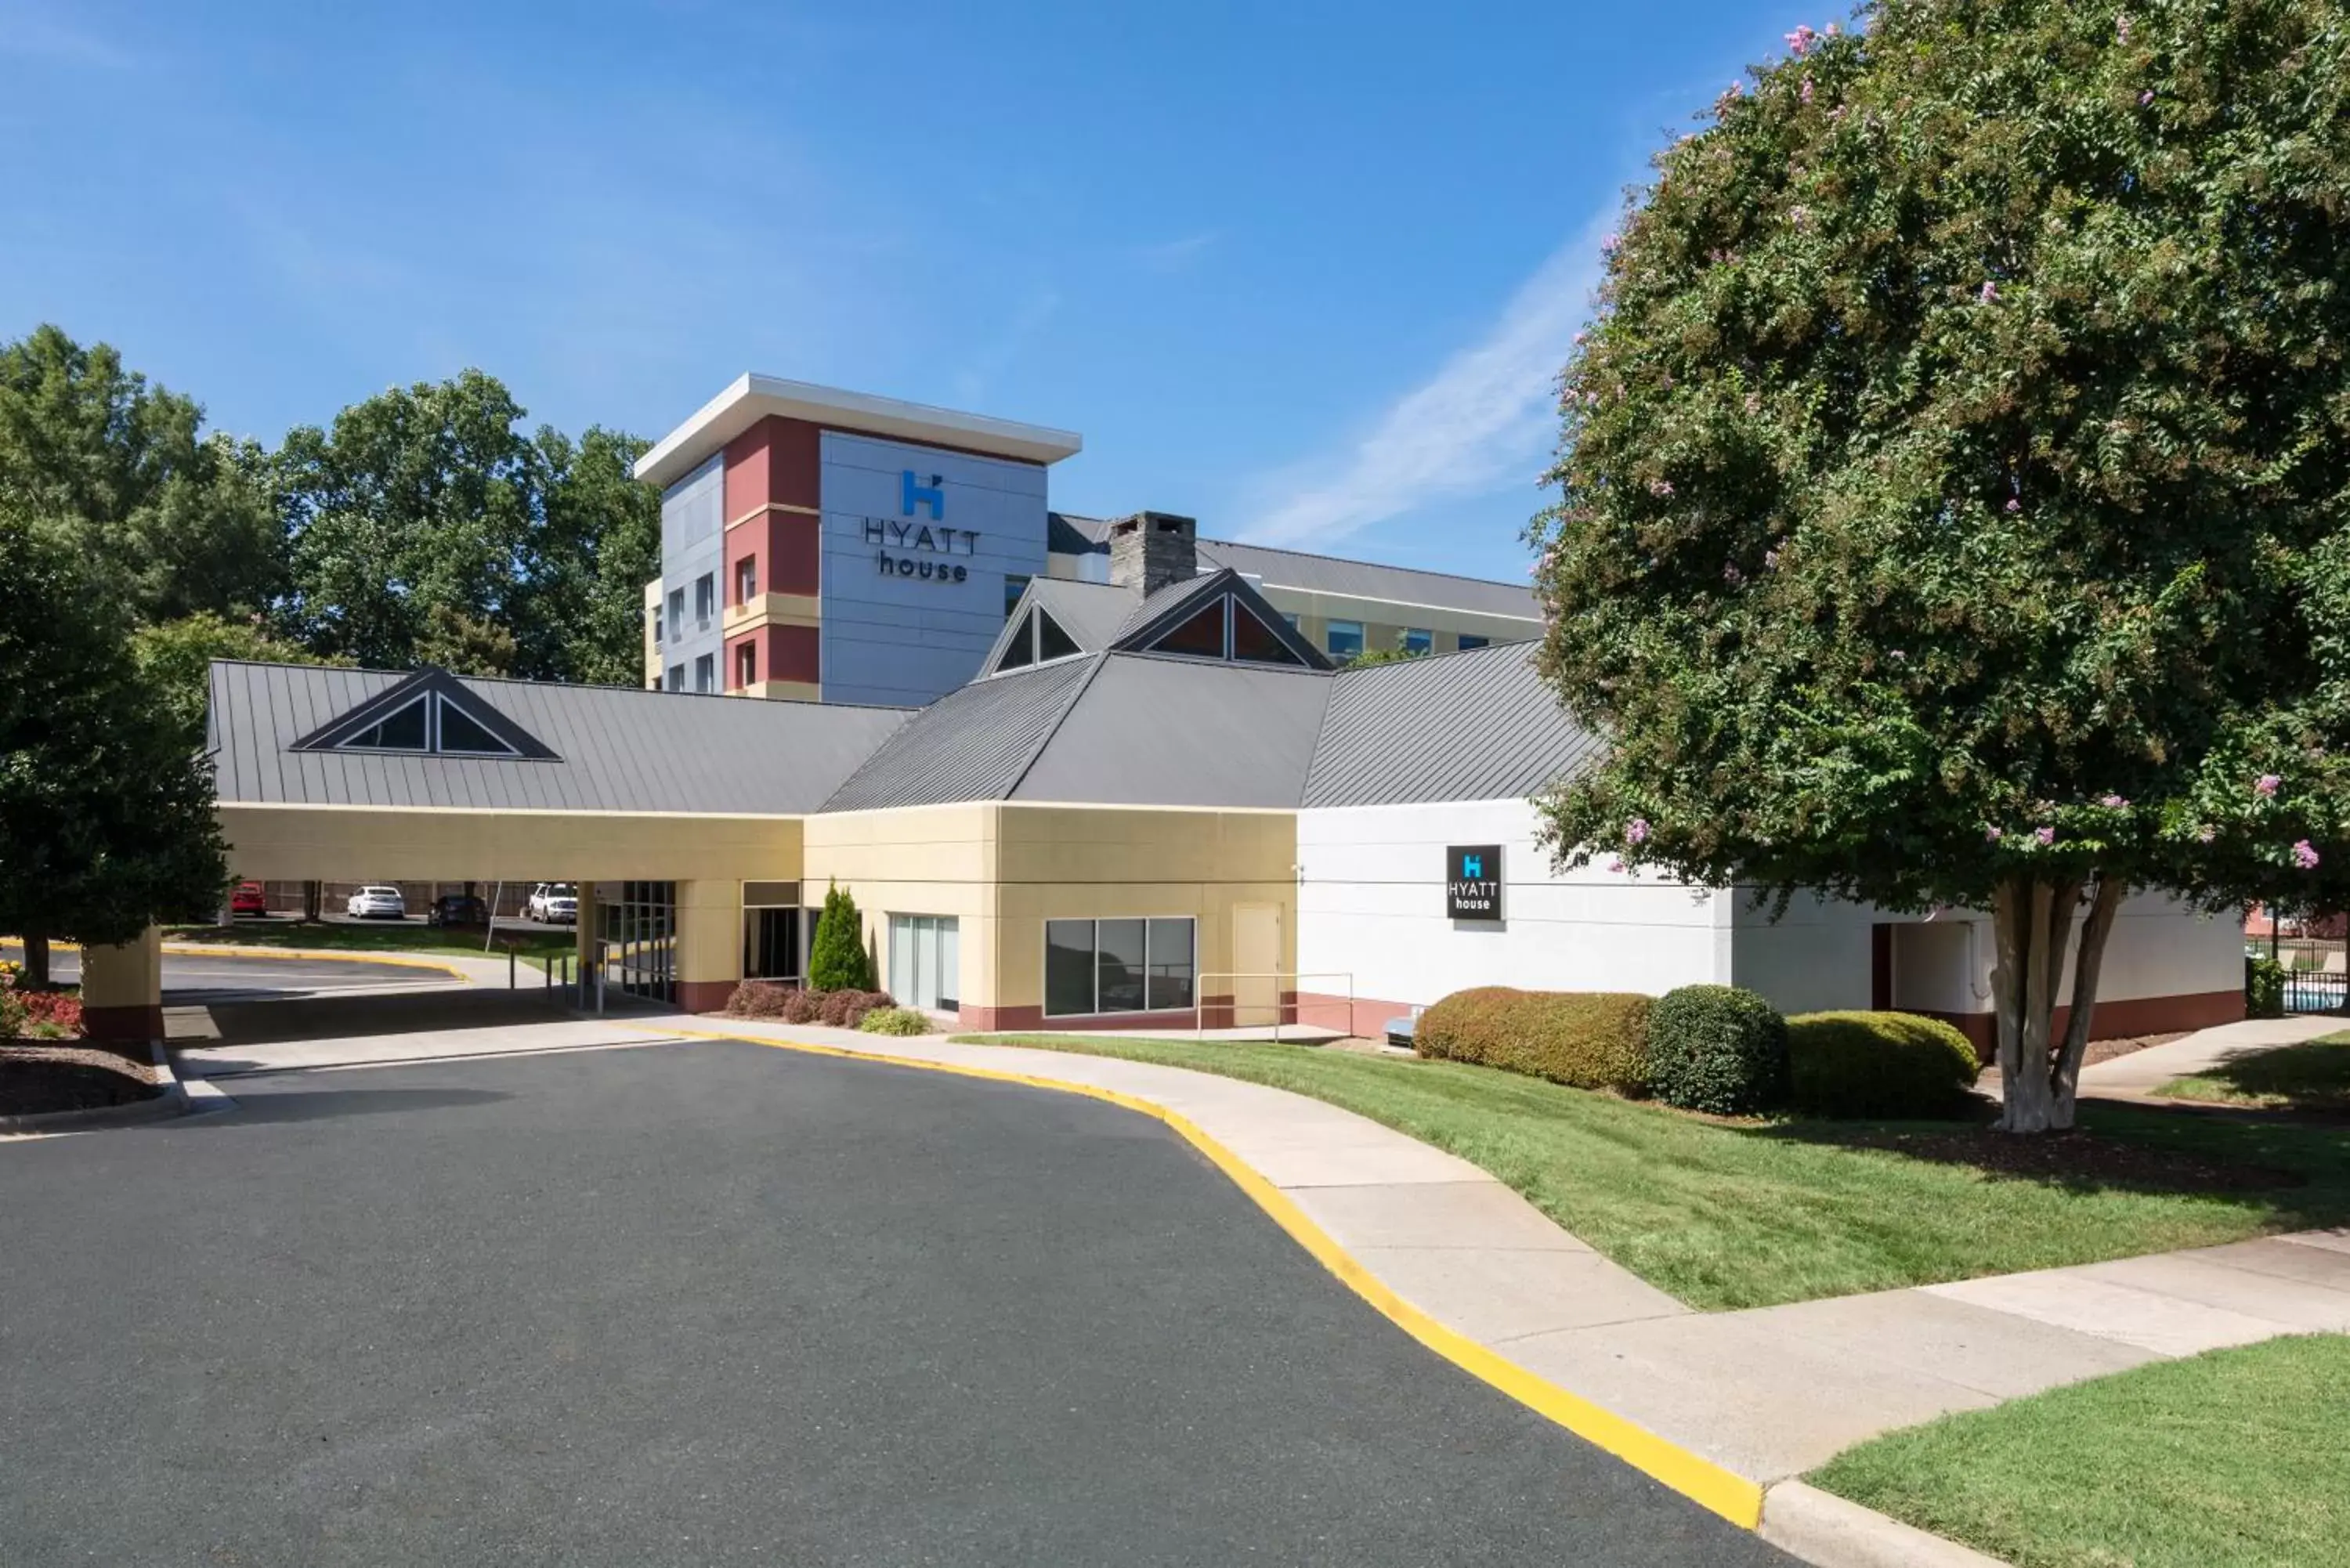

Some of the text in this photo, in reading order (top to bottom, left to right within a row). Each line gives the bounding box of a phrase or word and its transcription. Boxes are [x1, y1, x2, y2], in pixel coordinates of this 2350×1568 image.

[866, 516, 981, 555] HYATT
[880, 550, 967, 582] house
[1448, 882, 1496, 896] HYATT
[1456, 897, 1490, 909] house
